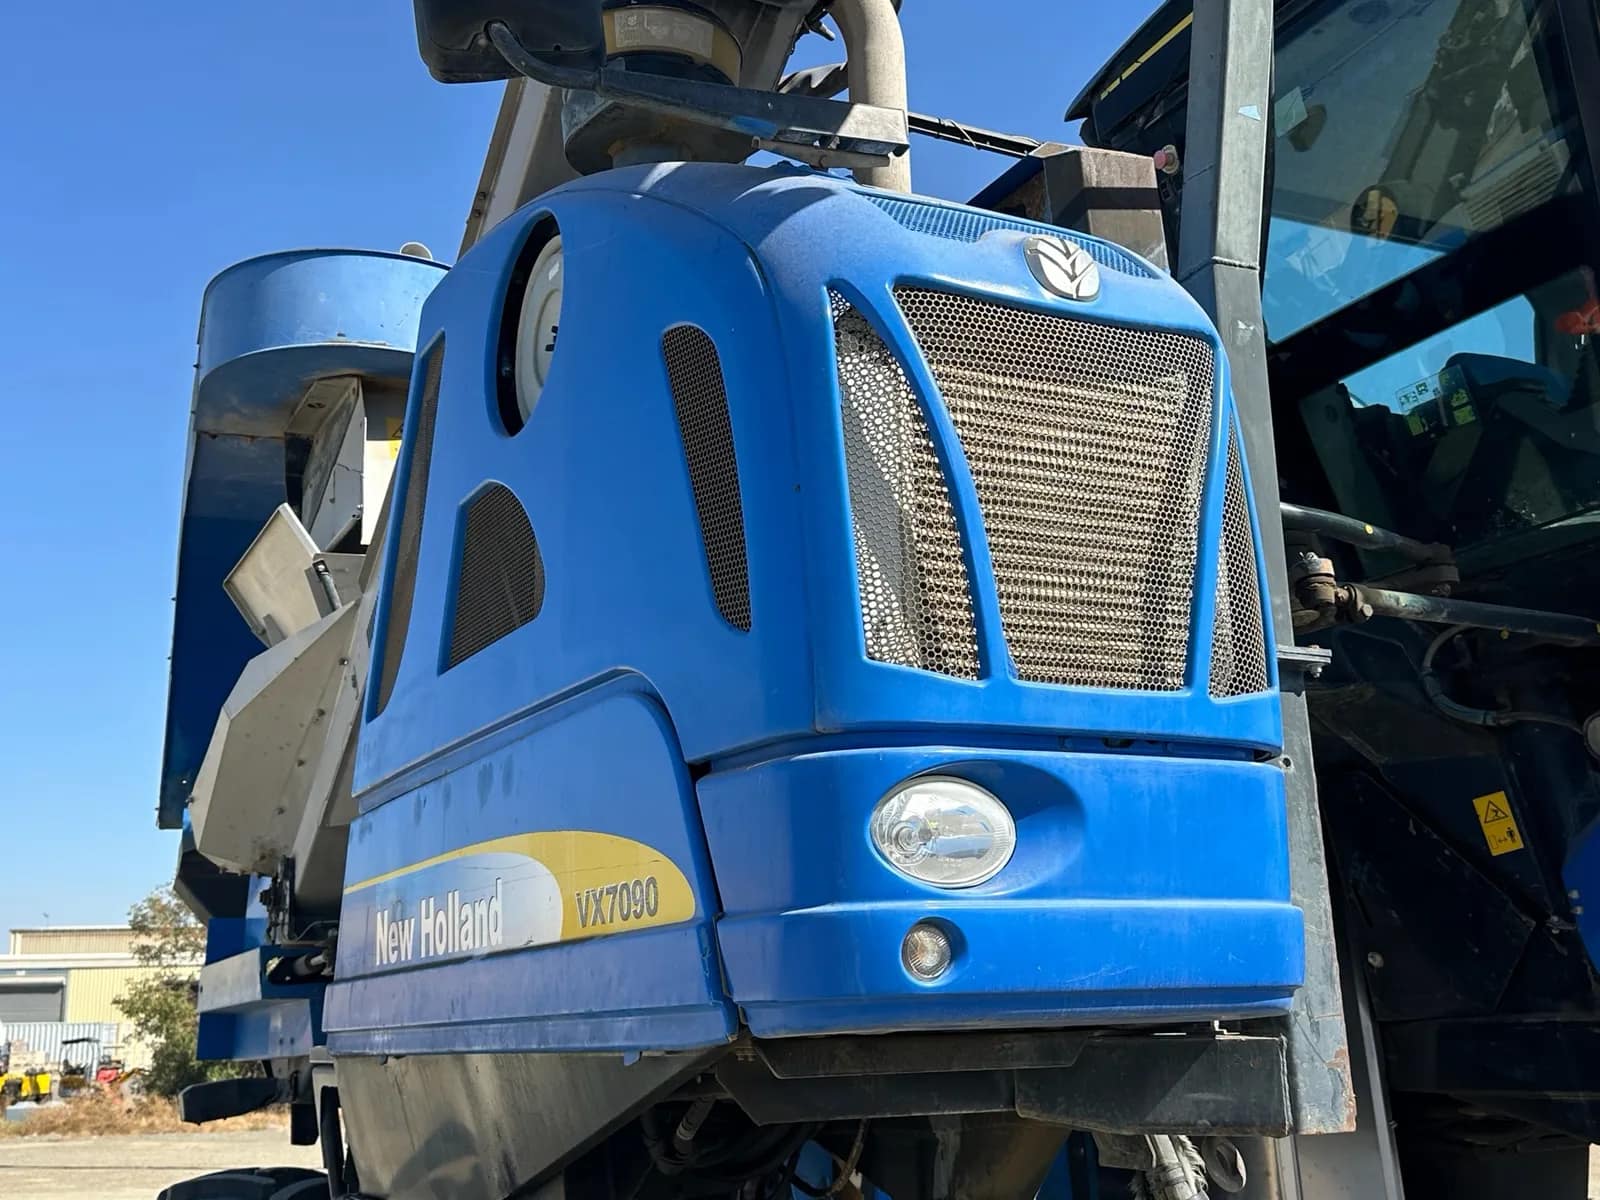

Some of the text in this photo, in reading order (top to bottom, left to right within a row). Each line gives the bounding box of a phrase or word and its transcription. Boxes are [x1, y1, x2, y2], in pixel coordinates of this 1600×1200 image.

[376, 878, 503, 965] New Holland
[576, 877, 659, 928] VX7090
